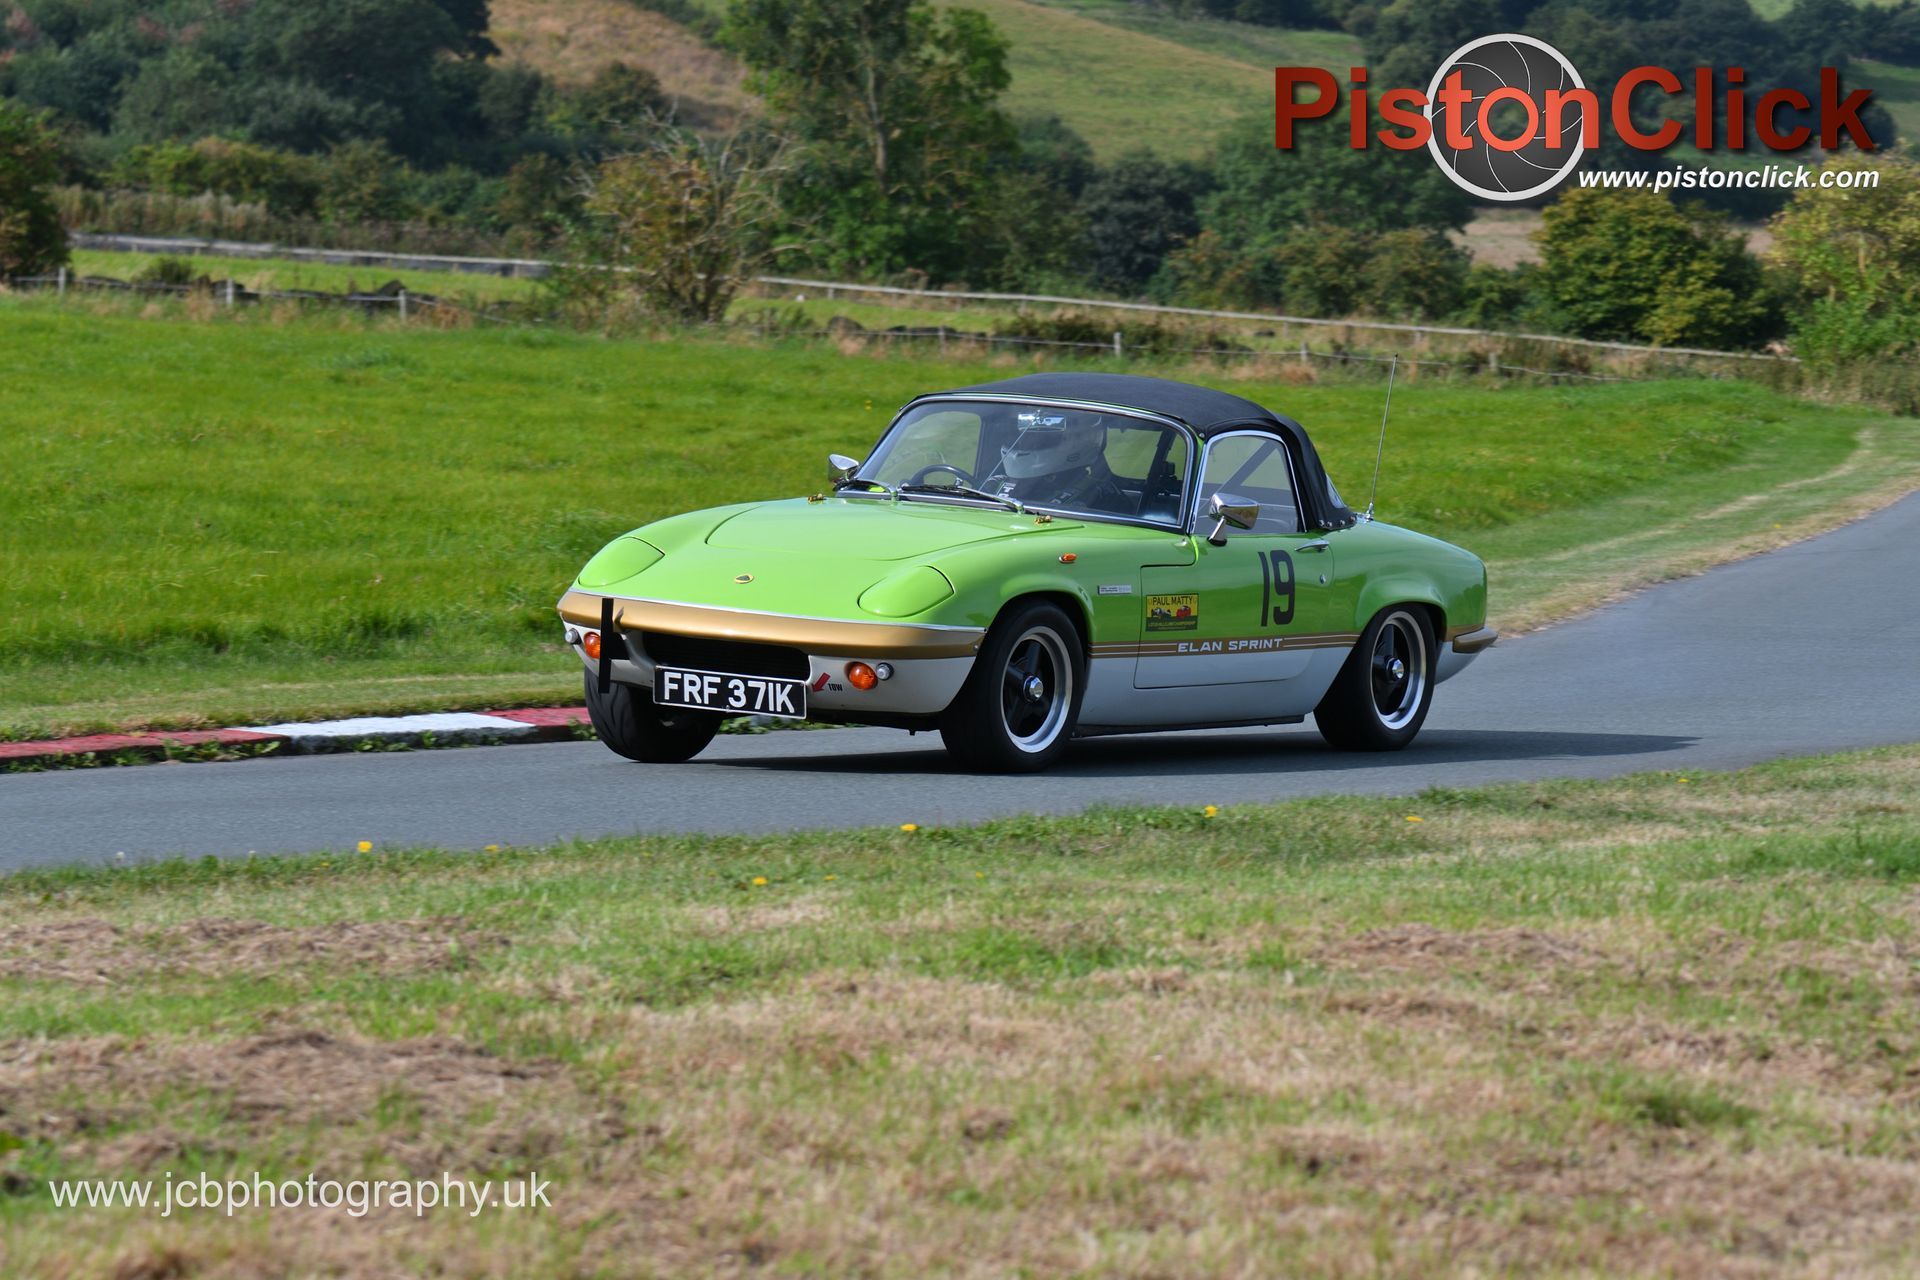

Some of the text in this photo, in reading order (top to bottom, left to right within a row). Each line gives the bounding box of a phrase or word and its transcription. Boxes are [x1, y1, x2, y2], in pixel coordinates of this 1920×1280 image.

[1258, 550, 1295, 627] 19
[1152, 595, 1193, 606] PAUL MATTY
[1178, 638, 1283, 653] ELAN SPRINT
[664, 671, 795, 714] FRF 371K
[827, 682, 843, 692] TOW
